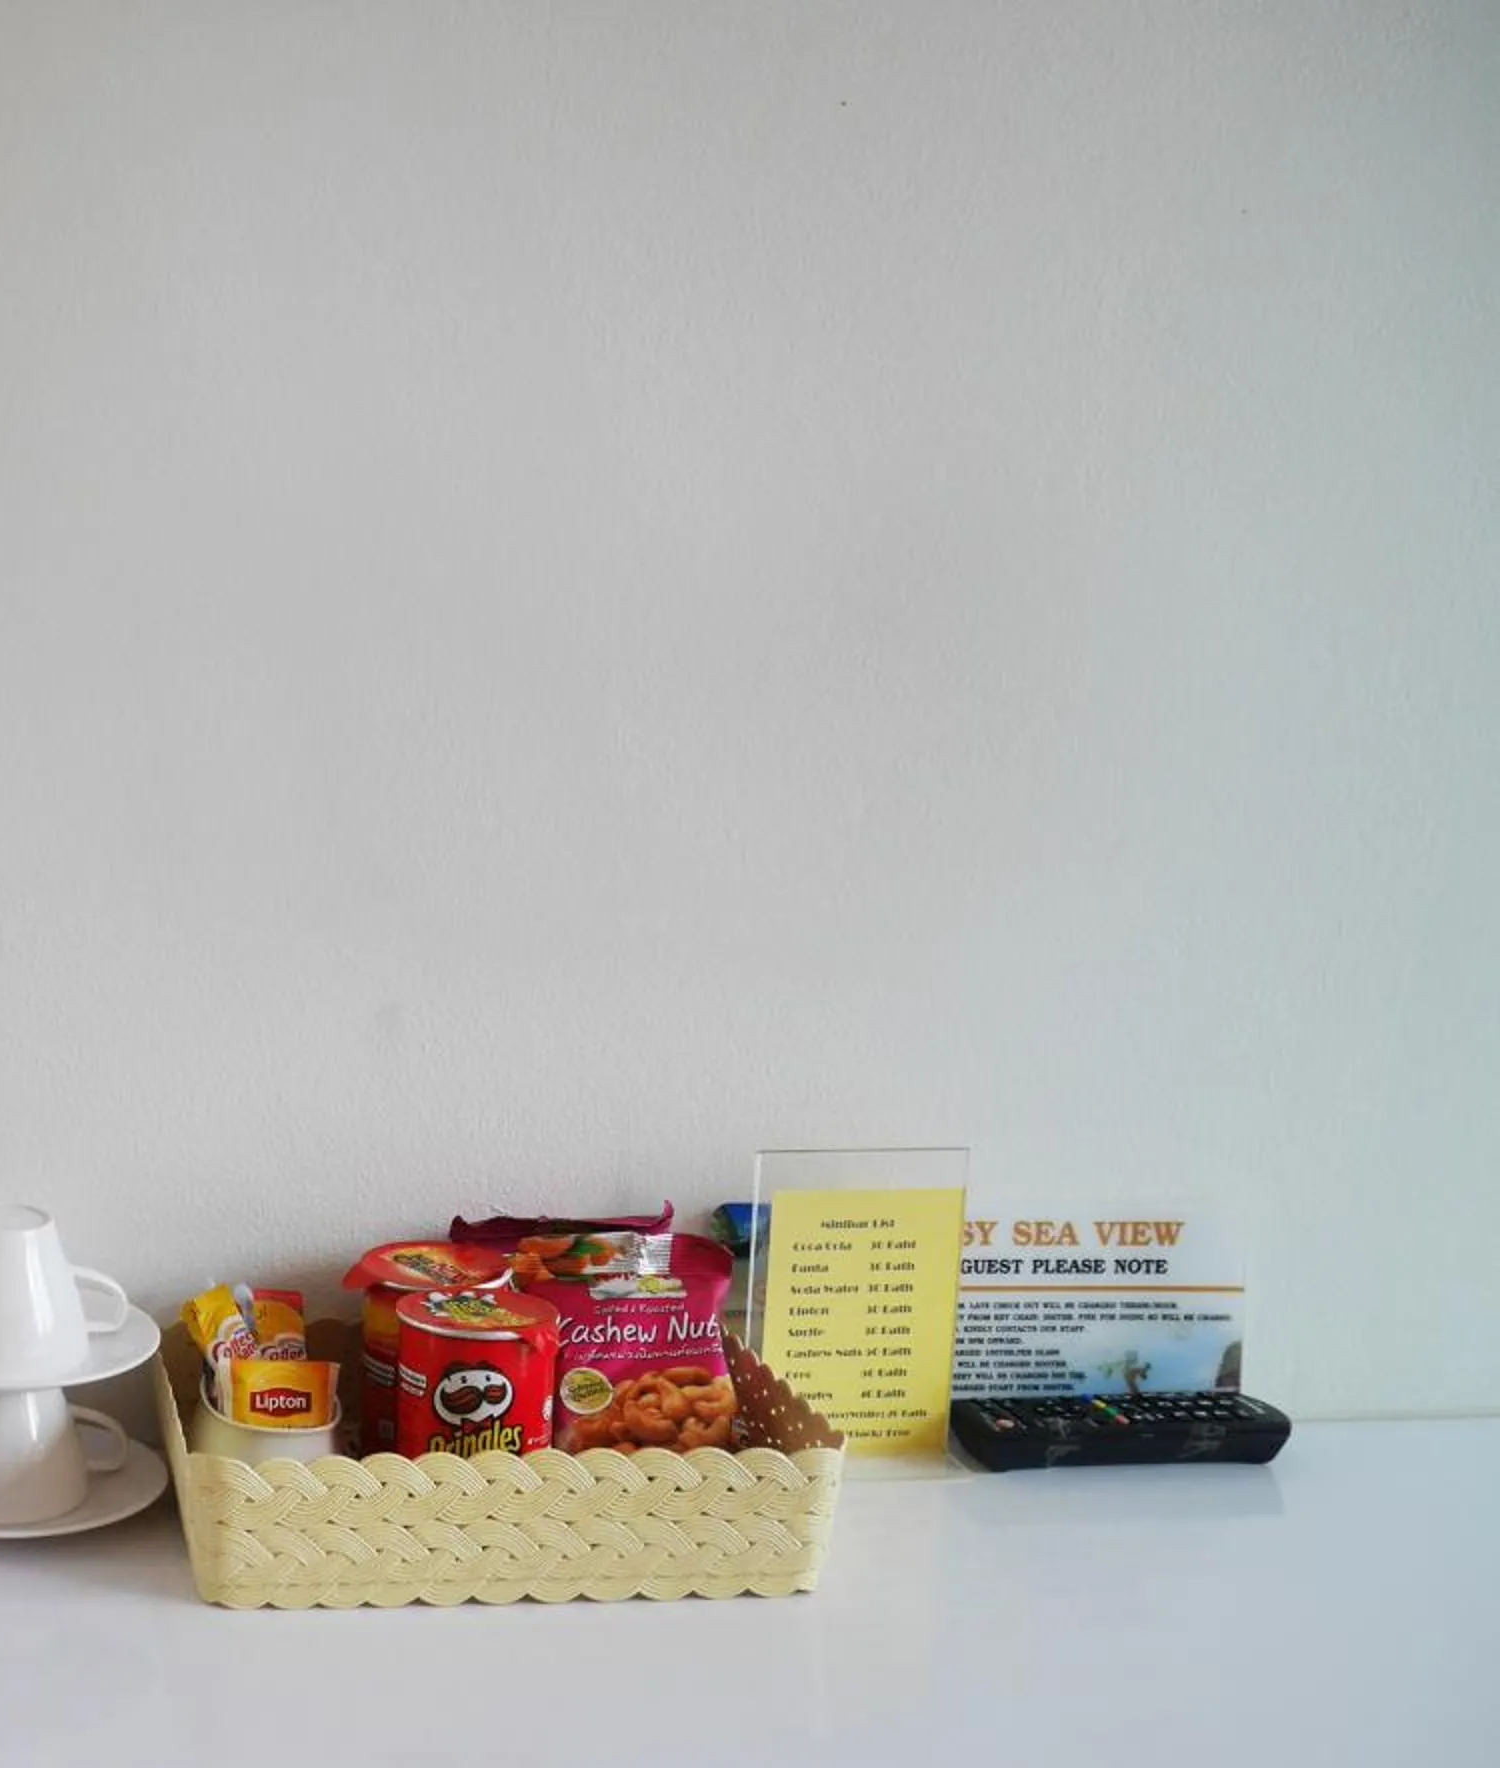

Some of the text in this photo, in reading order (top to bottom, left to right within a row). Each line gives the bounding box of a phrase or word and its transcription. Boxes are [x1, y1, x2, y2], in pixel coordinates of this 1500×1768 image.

[1012, 1221, 1080, 1247] SEA
[1093, 1221, 1186, 1247] VIEW
[791, 1262, 829, 1273] Fanta
[960, 1258, 1169, 1275] GUEST PLEASE NOTE
[557, 1315, 657, 1347] Cashew
[255, 1392, 307, 1412] Lipton
